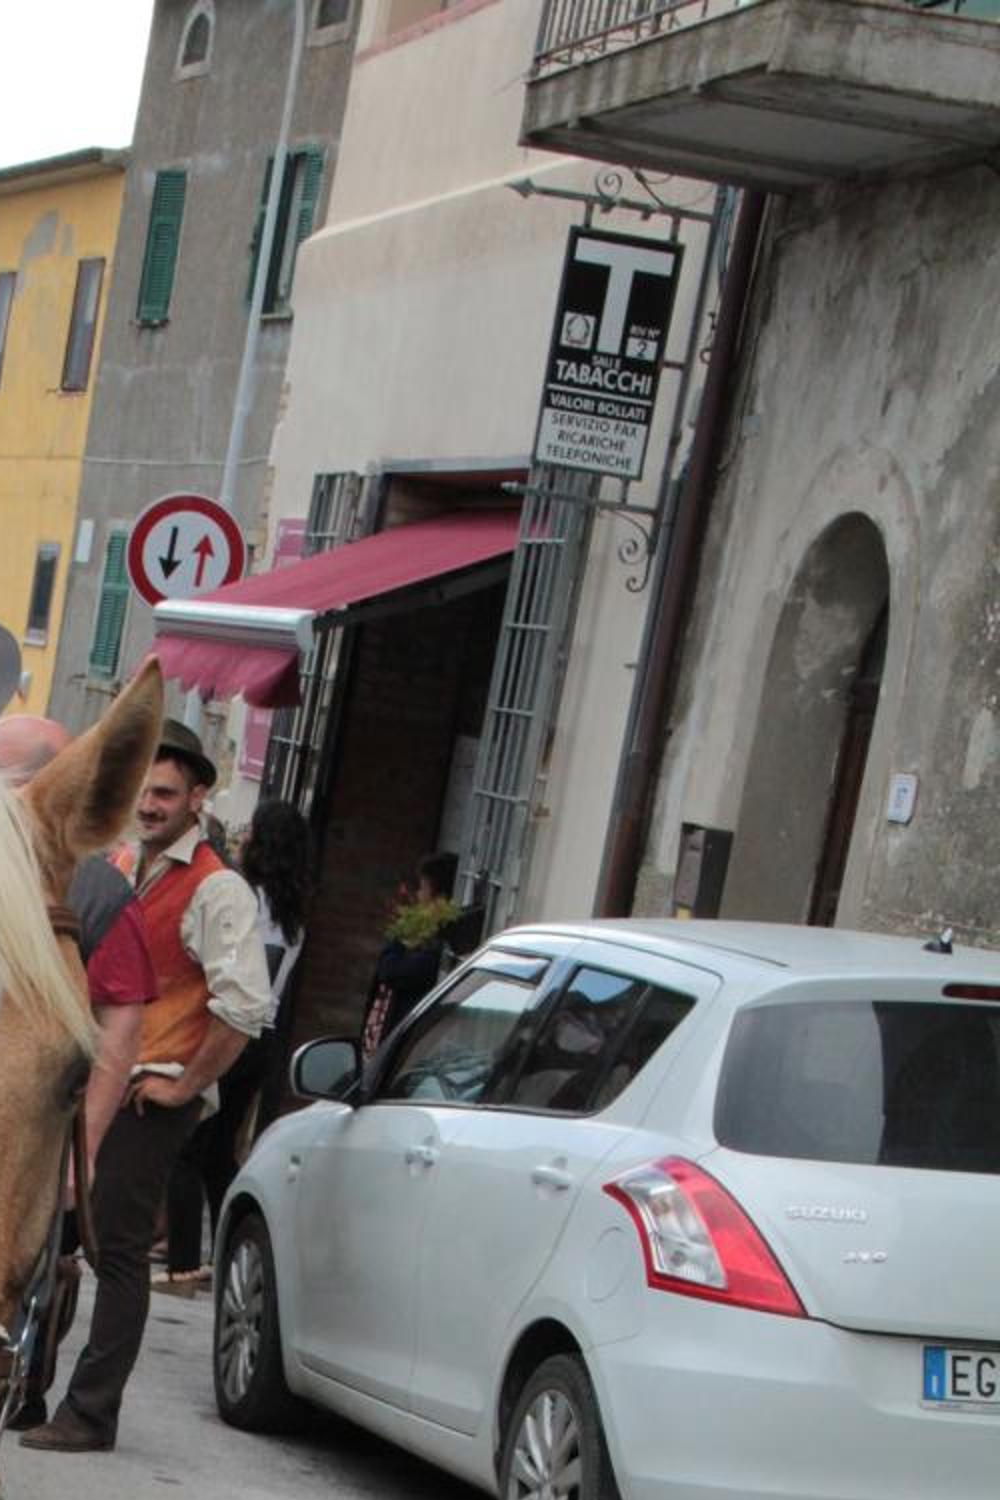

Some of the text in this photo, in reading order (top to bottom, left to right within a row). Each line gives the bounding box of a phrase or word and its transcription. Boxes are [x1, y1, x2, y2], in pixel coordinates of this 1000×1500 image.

[574, 237, 675, 354] T
[638, 341, 647, 357] 2
[556, 359, 652, 395] TABACCHI
[550, 392, 647, 421] VALORI BOLLATI
[551, 412, 637, 439] SERVIZIO FAX
[558, 429, 626, 453] RICARICHE
[546, 442, 632, 470] TELEFONICHE
